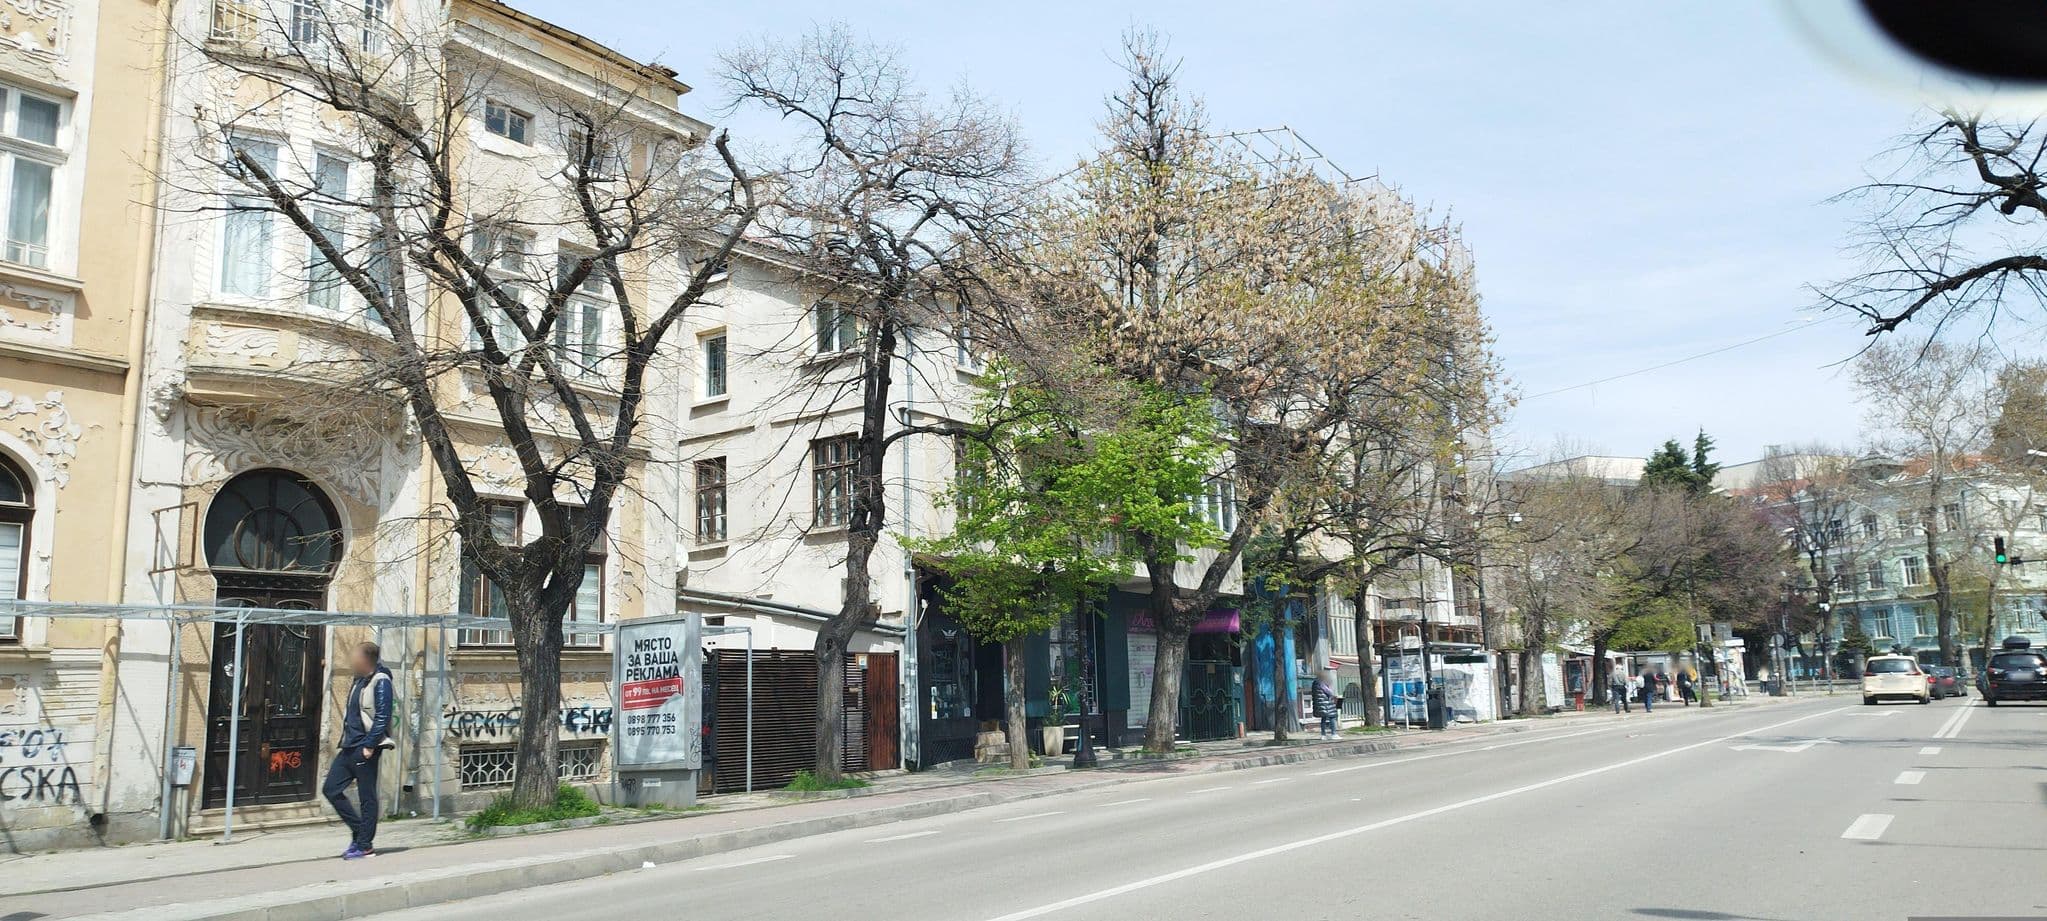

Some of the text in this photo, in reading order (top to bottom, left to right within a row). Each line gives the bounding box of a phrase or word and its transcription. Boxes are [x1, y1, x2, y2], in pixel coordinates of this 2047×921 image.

[635, 637, 671, 652] МЯСТО
[628, 651, 678, 667] ЗА ВАША
[626, 665, 680, 681] РЕКЛАМА
[633, 687, 642, 697] 99
[628, 713, 675, 724] 0898 777 356
[628, 725, 675, 736] 0895 770 753
[0, 766, 82, 804] CSKA
